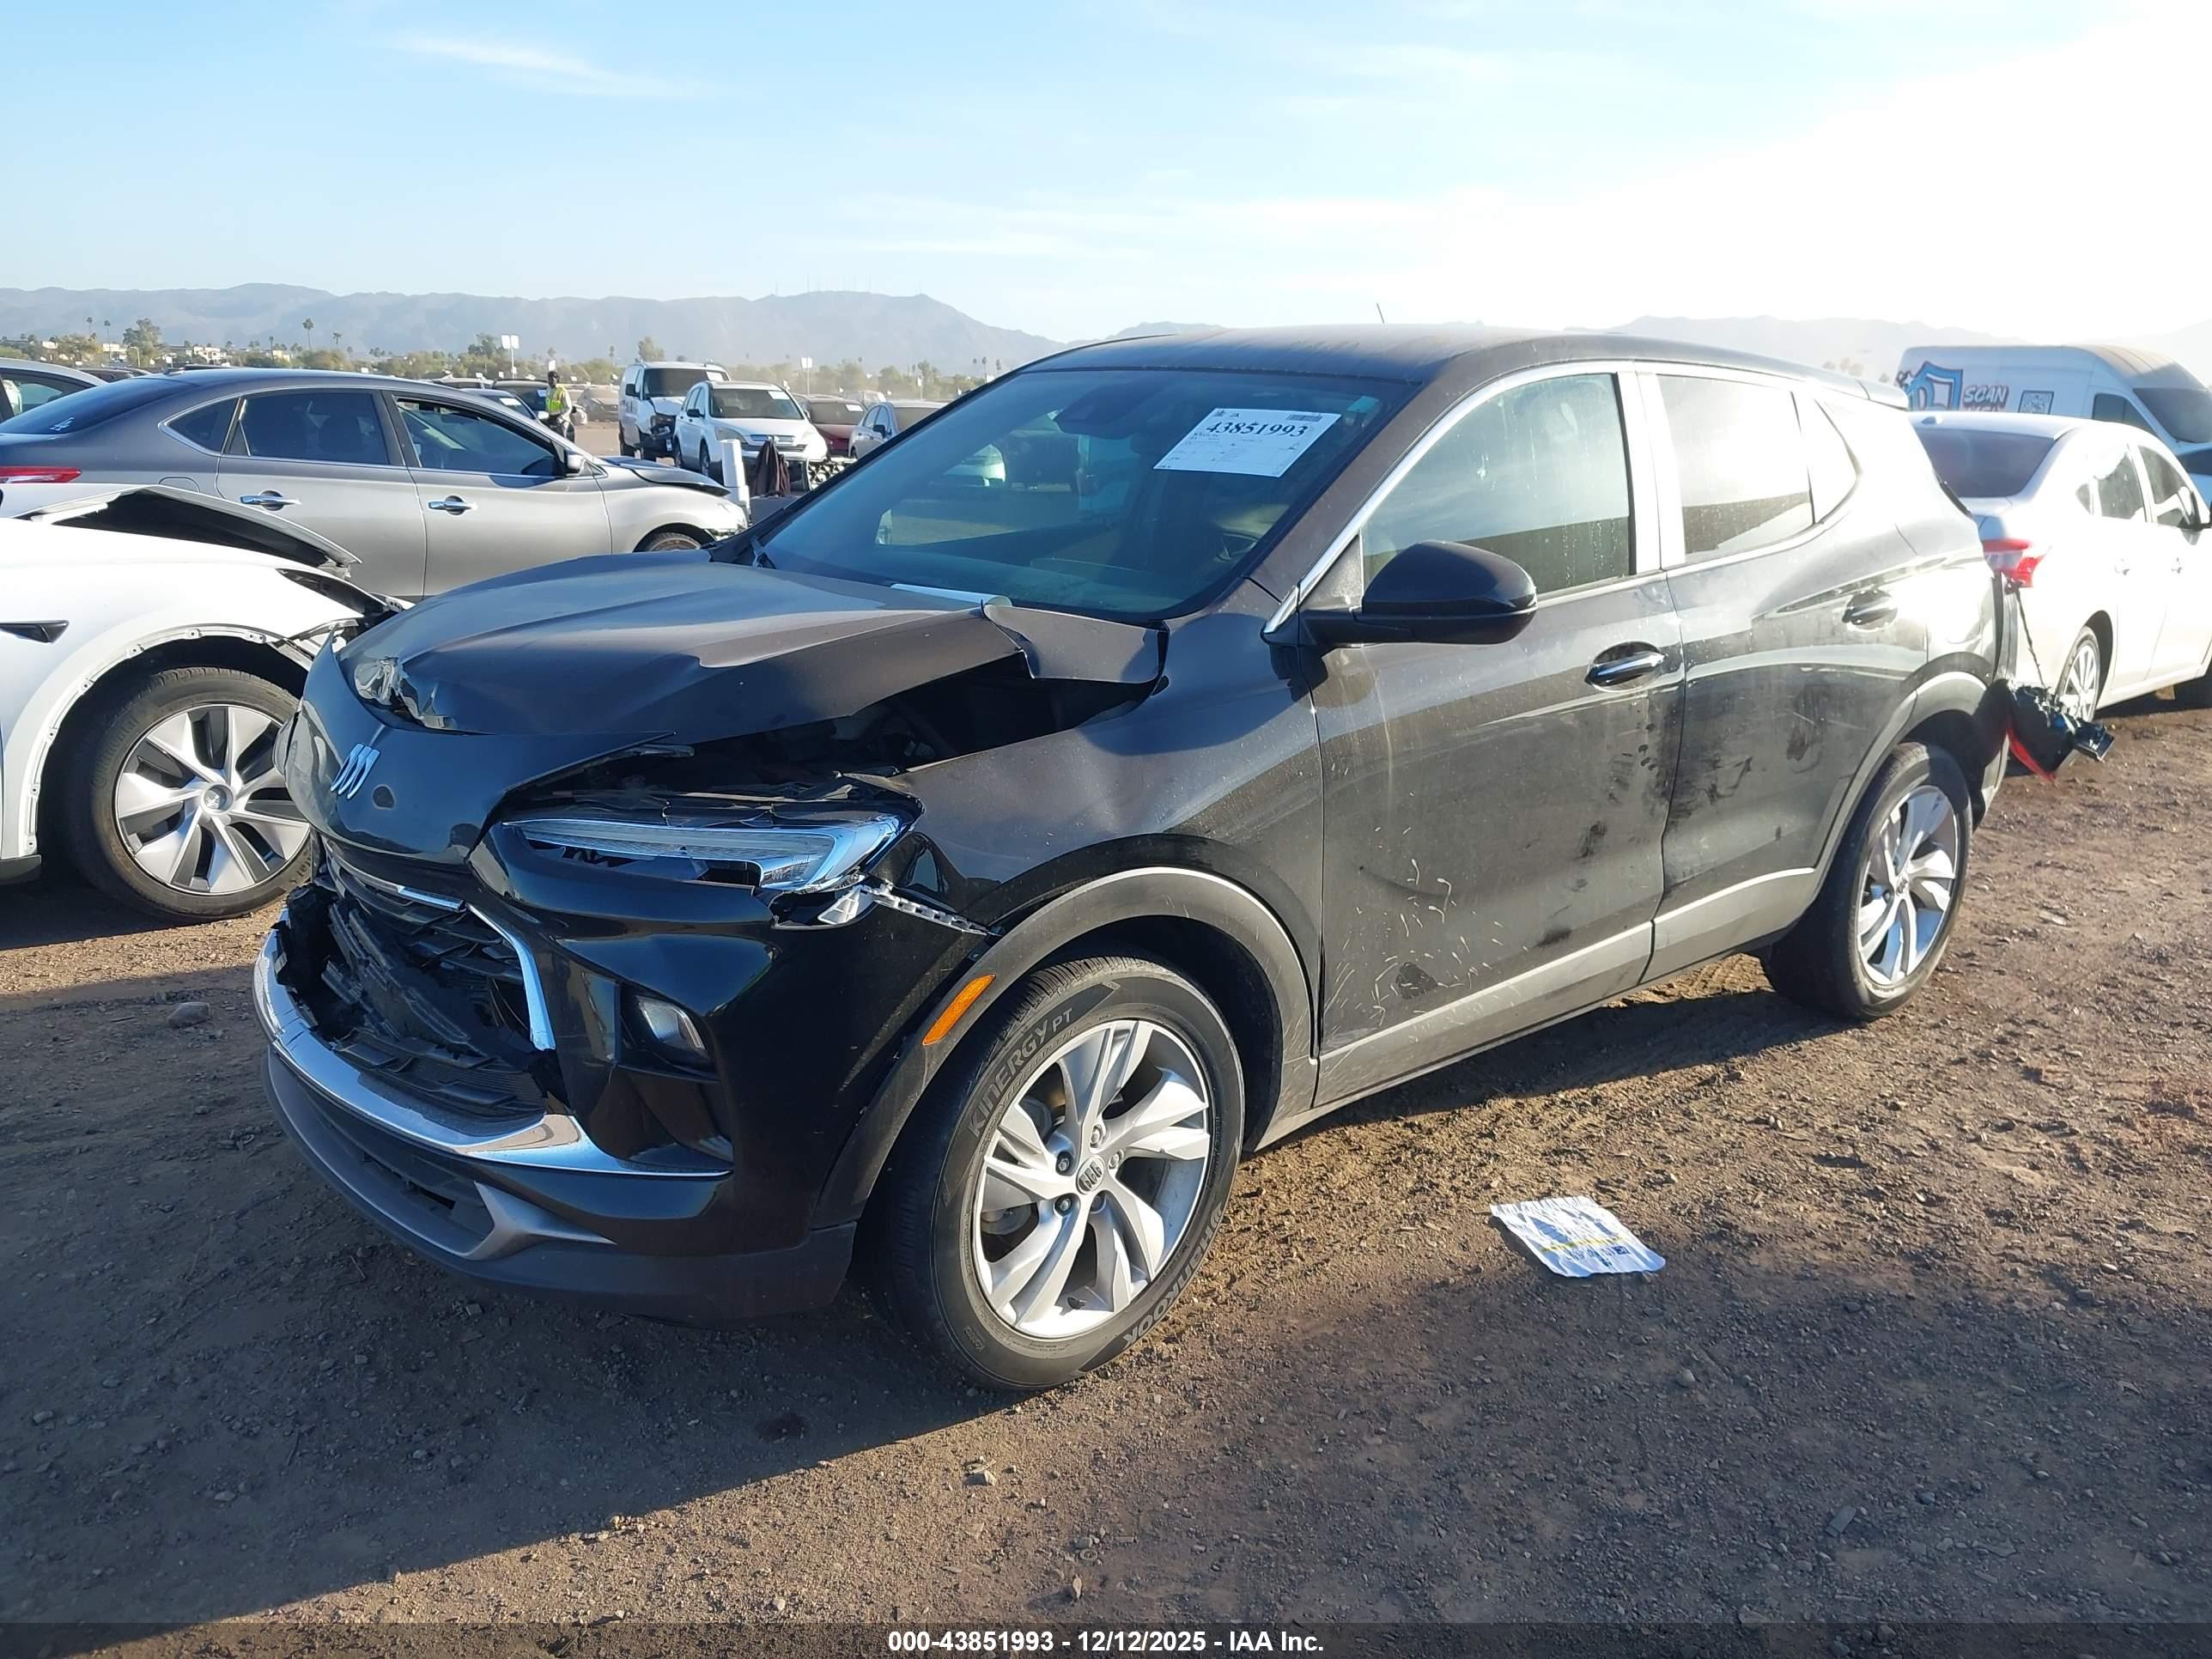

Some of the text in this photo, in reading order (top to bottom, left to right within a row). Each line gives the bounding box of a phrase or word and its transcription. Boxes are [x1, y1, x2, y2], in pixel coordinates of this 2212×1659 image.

[1964, 385, 2008, 406] SCAN
[1206, 421, 1309, 437] 43851993
[1052, 1008, 1073, 1033] PT
